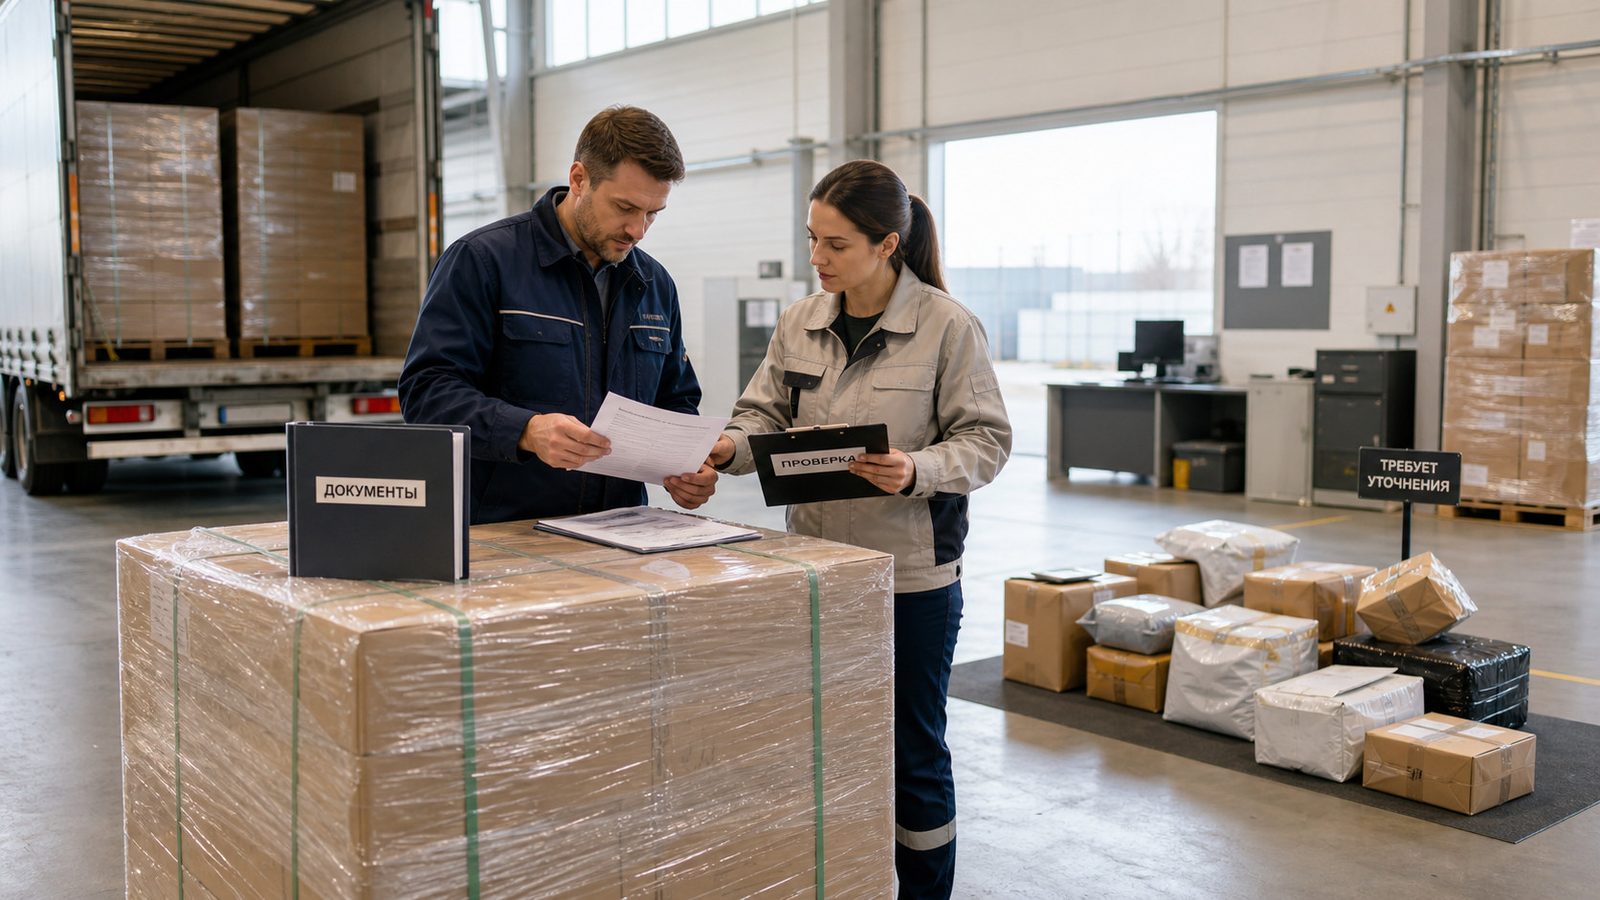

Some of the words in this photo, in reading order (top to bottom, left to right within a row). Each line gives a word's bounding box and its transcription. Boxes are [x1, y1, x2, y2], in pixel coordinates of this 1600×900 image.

[781, 455, 856, 468] ПРОВЕРКА
[1380, 459, 1438, 474] ТРЕБУЕТ
[1368, 475, 1450, 492] УТОЧНЕНИЯ
[324, 484, 417, 499] ДОКУМЕНТЫ
